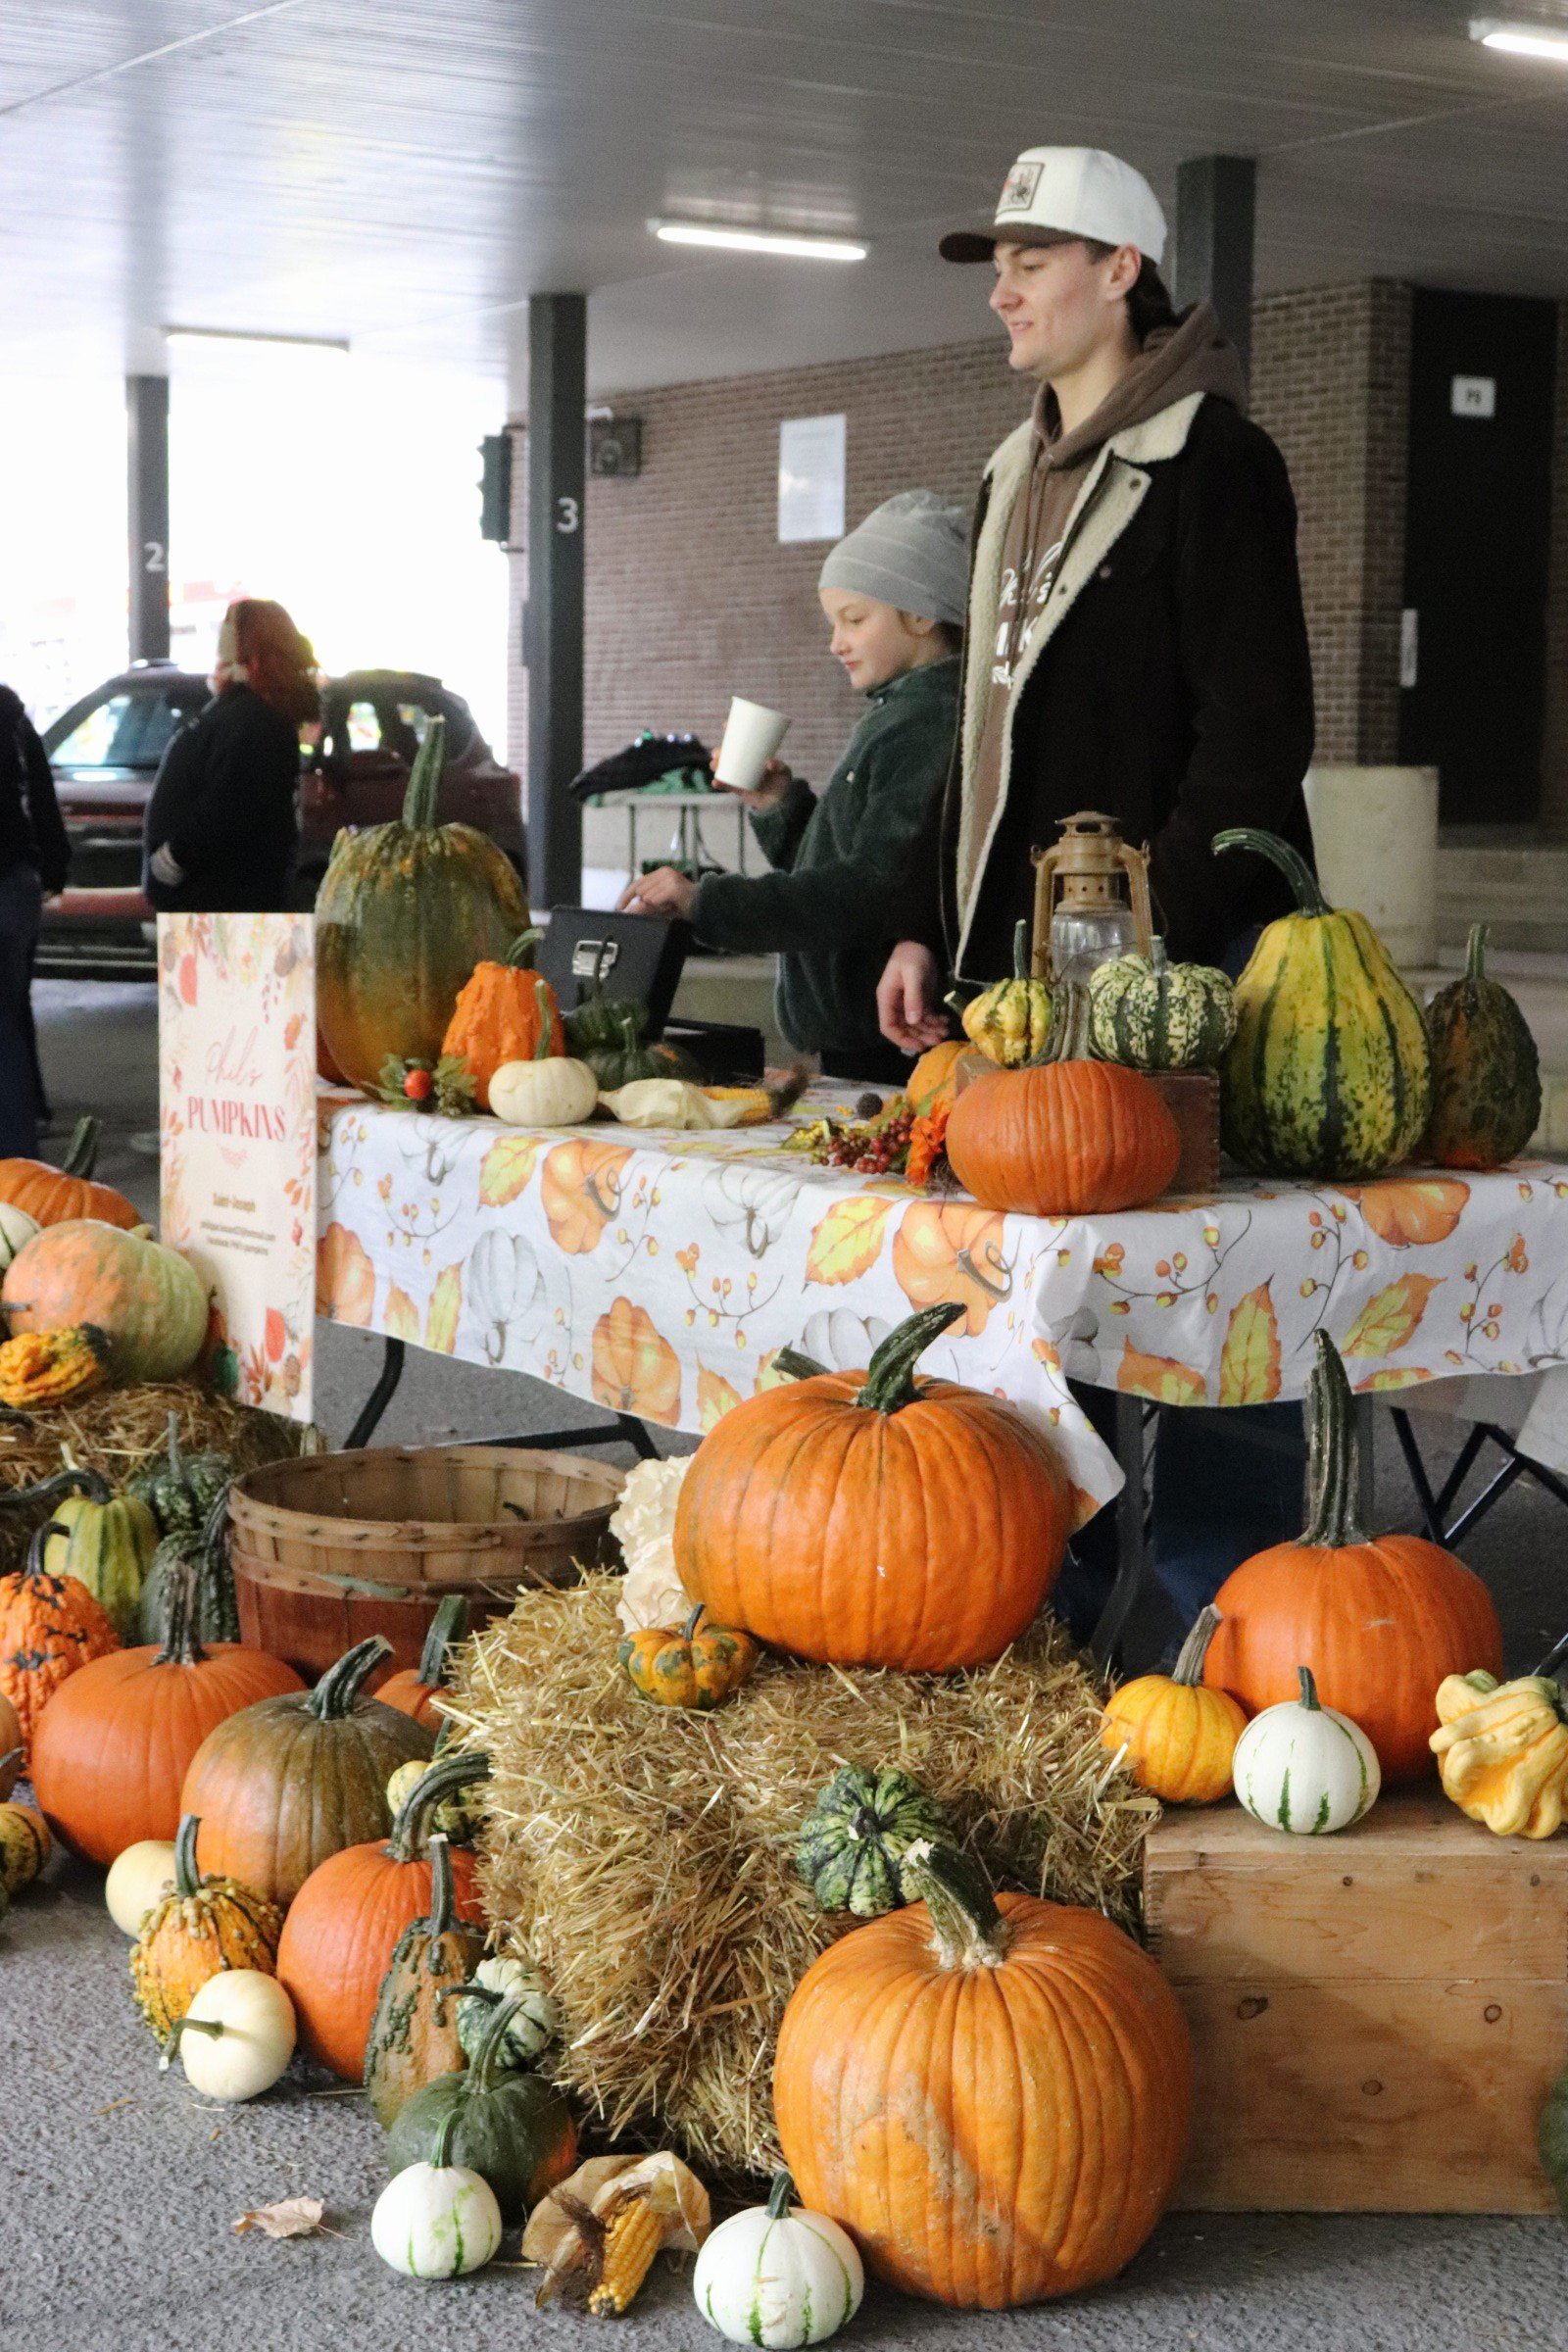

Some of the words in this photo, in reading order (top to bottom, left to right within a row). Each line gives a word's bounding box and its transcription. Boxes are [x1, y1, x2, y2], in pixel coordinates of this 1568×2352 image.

[558, 497, 578, 533] 3
[144, 542, 166, 572] 2
[188, 1096, 285, 1142] PUMPKINS
